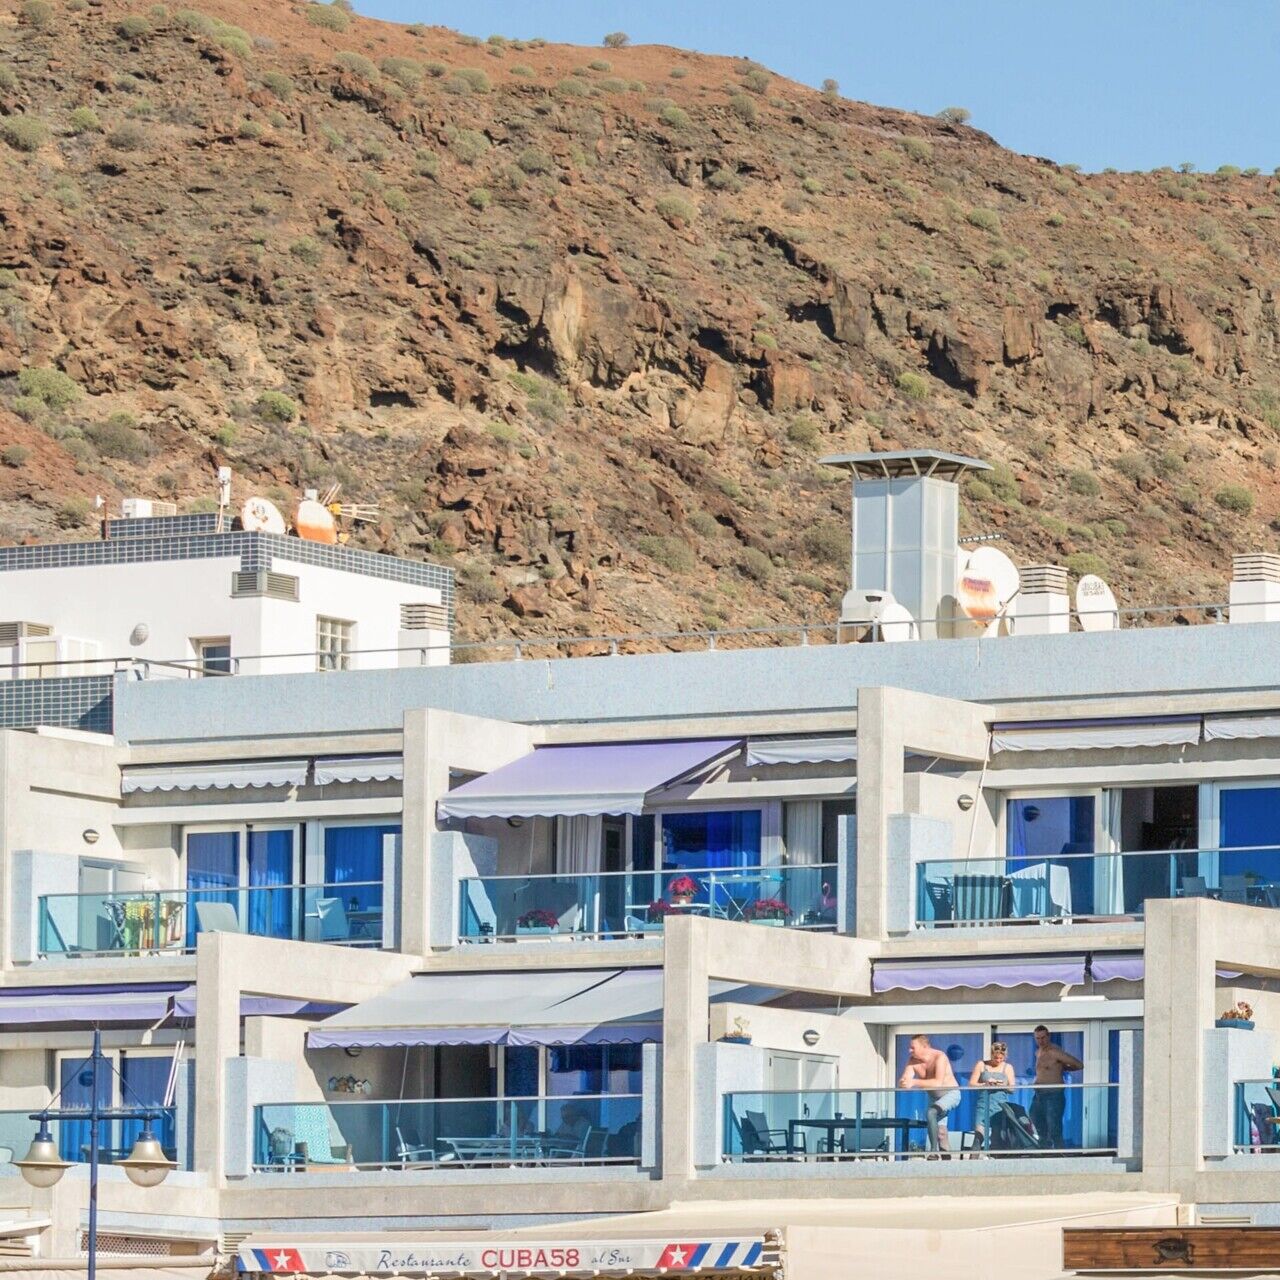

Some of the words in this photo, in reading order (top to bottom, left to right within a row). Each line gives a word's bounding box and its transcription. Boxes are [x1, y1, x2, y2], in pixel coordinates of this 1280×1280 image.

[376, 1249, 472, 1269] Restaurante
[480, 1248, 580, 1268] CUBA58
[607, 1249, 634, 1265] Sur
